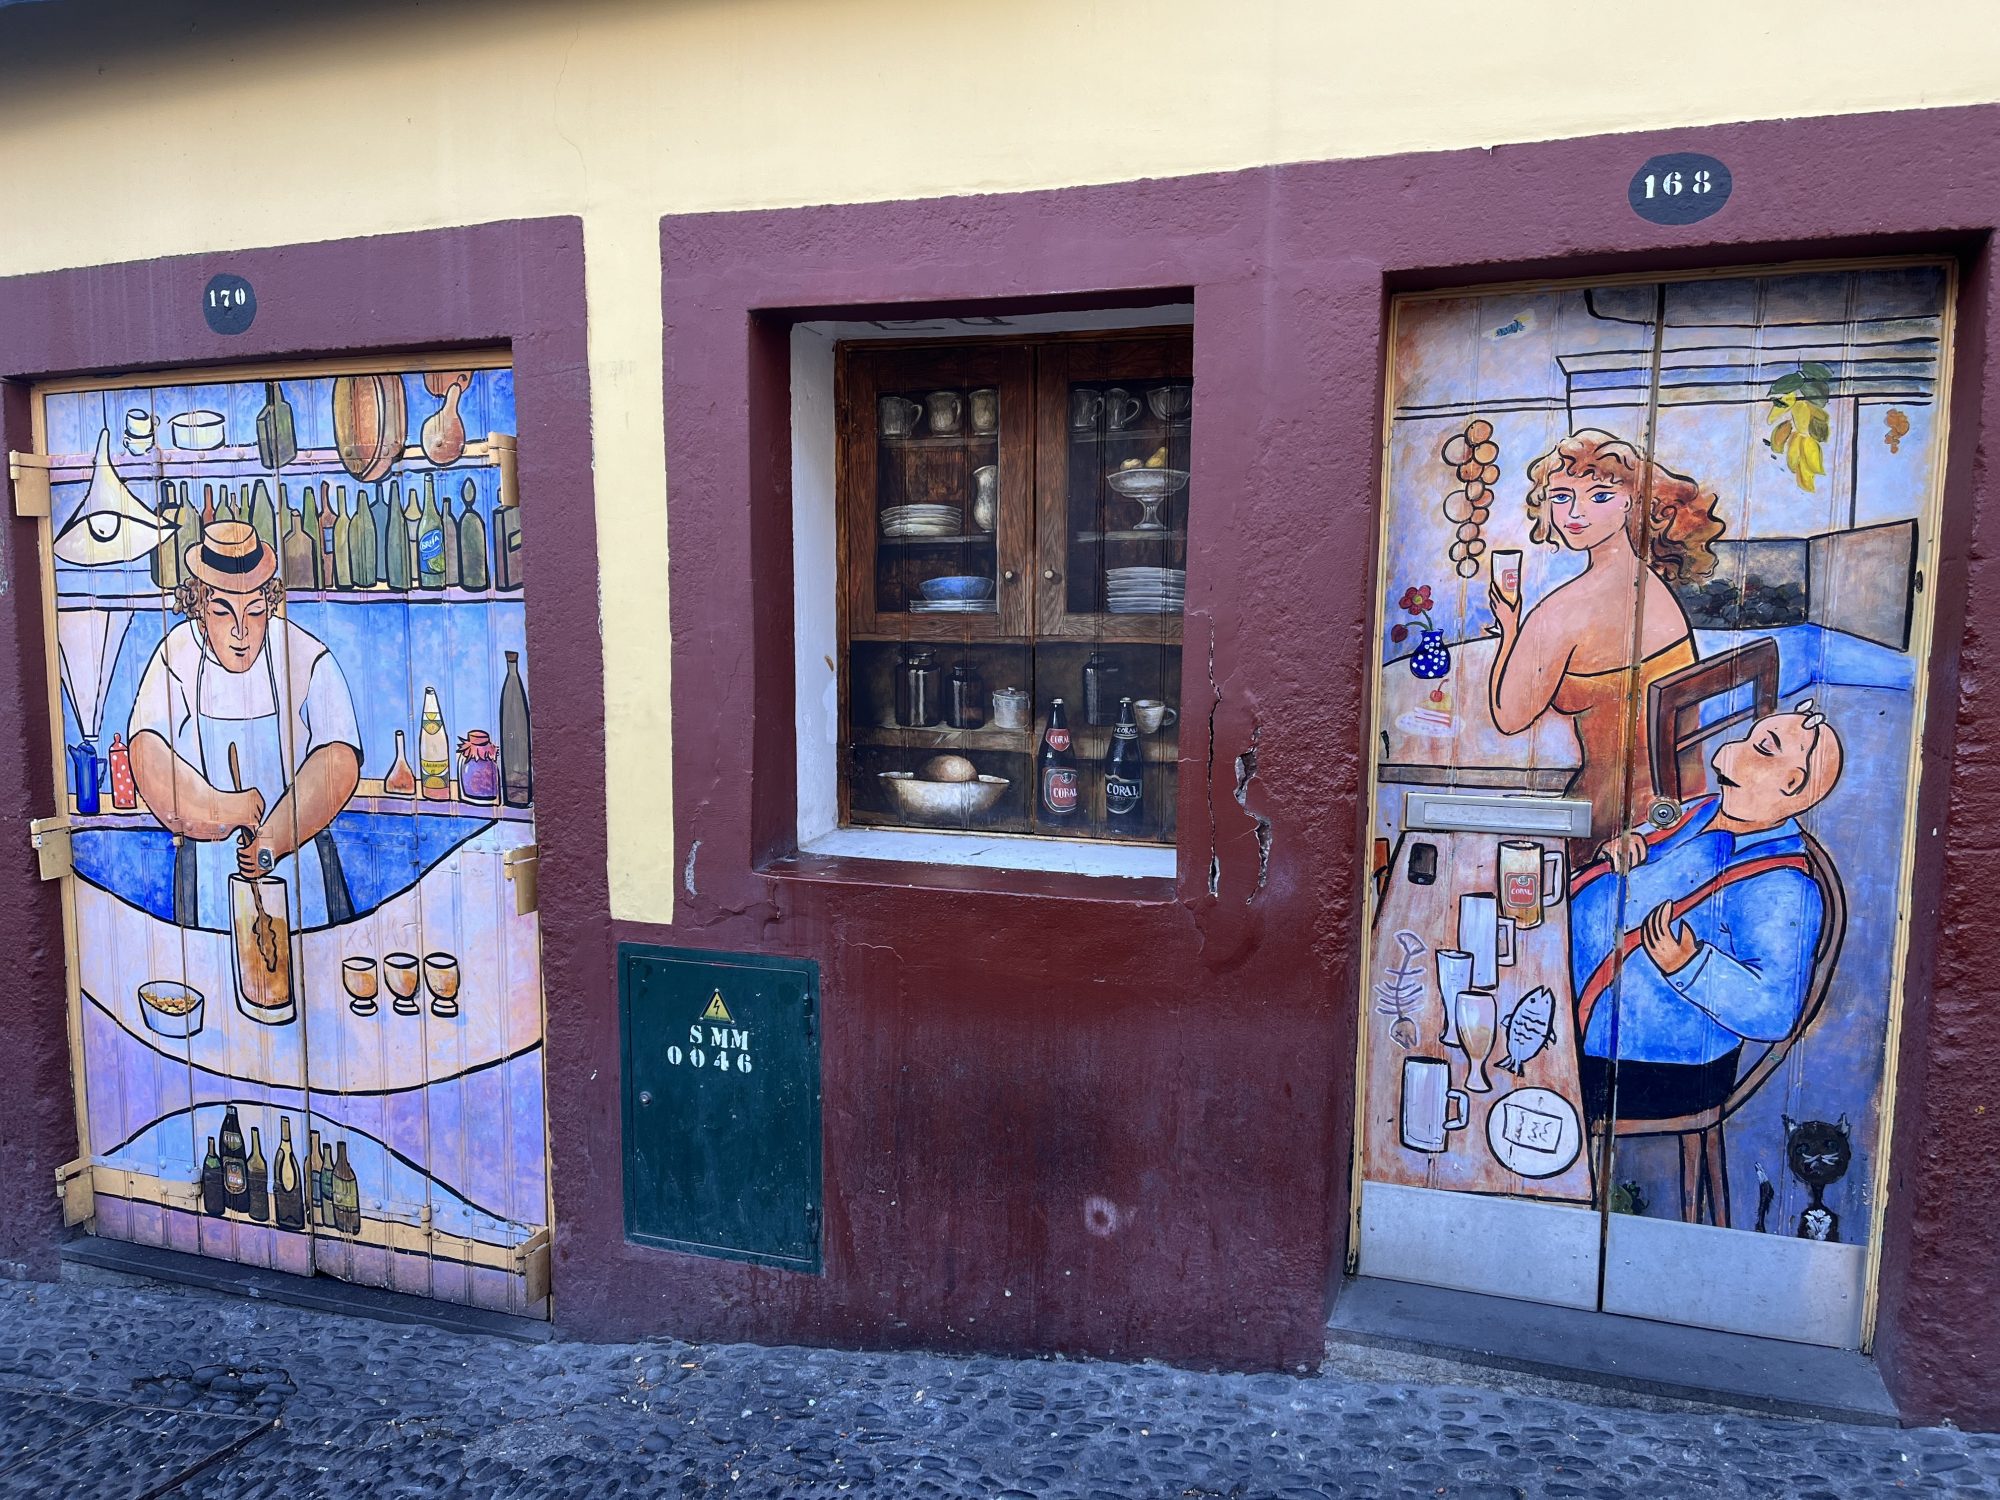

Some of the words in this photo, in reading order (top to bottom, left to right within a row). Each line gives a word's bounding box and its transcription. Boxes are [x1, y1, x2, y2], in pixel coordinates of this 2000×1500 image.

[1644, 170, 1711, 199] 168
[209, 287, 246, 307] 170
[1053, 787, 1077, 798] CORAL
[1106, 782, 1139, 798] CORAL
[667, 1045, 752, 1073] 0046
